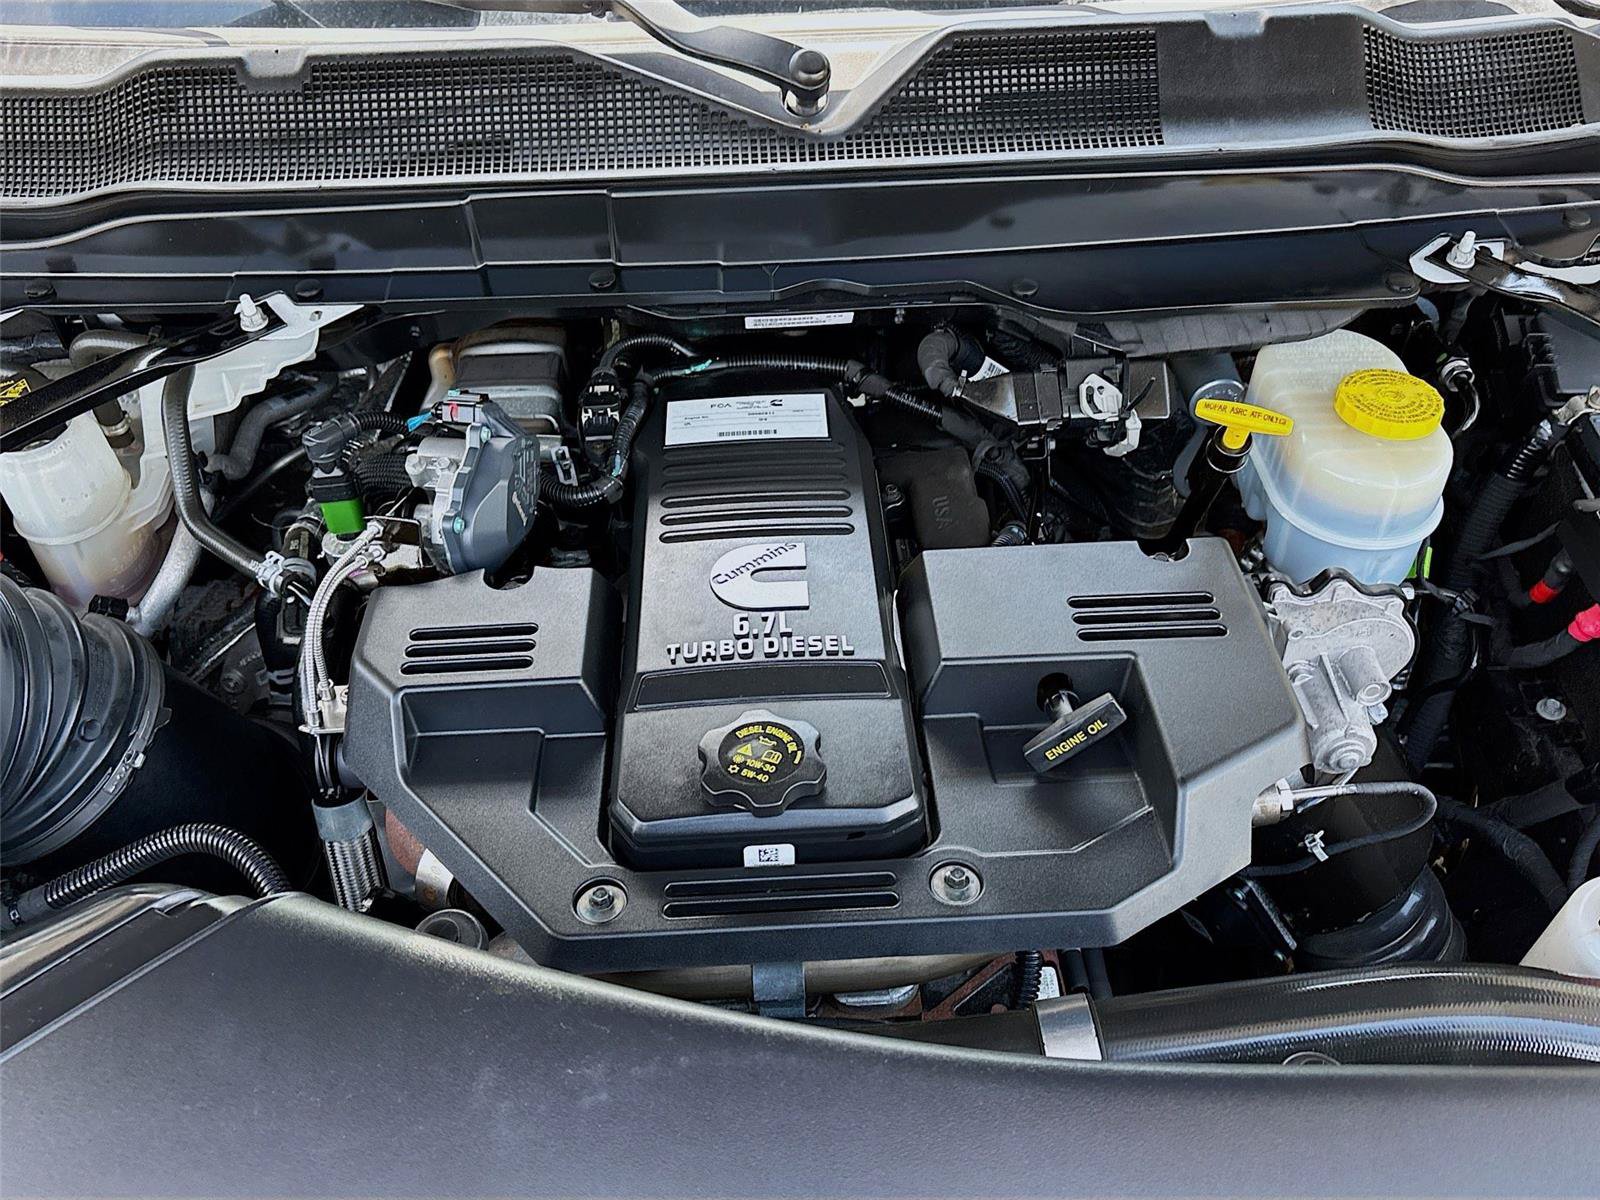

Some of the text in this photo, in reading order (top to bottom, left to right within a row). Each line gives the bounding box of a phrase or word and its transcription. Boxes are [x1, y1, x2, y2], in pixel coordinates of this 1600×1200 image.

[711, 541, 798, 585] Cummins
[733, 612, 793, 639] 6.7L
[666, 635, 855, 664] TURBO DIESEL
[735, 725, 802, 765] DIESEL ENGINE OIL
[1044, 719, 1108, 761] ENGINE OIL
[740, 768, 769, 783] 5W-40
[745, 758, 776, 773] 10W-30
